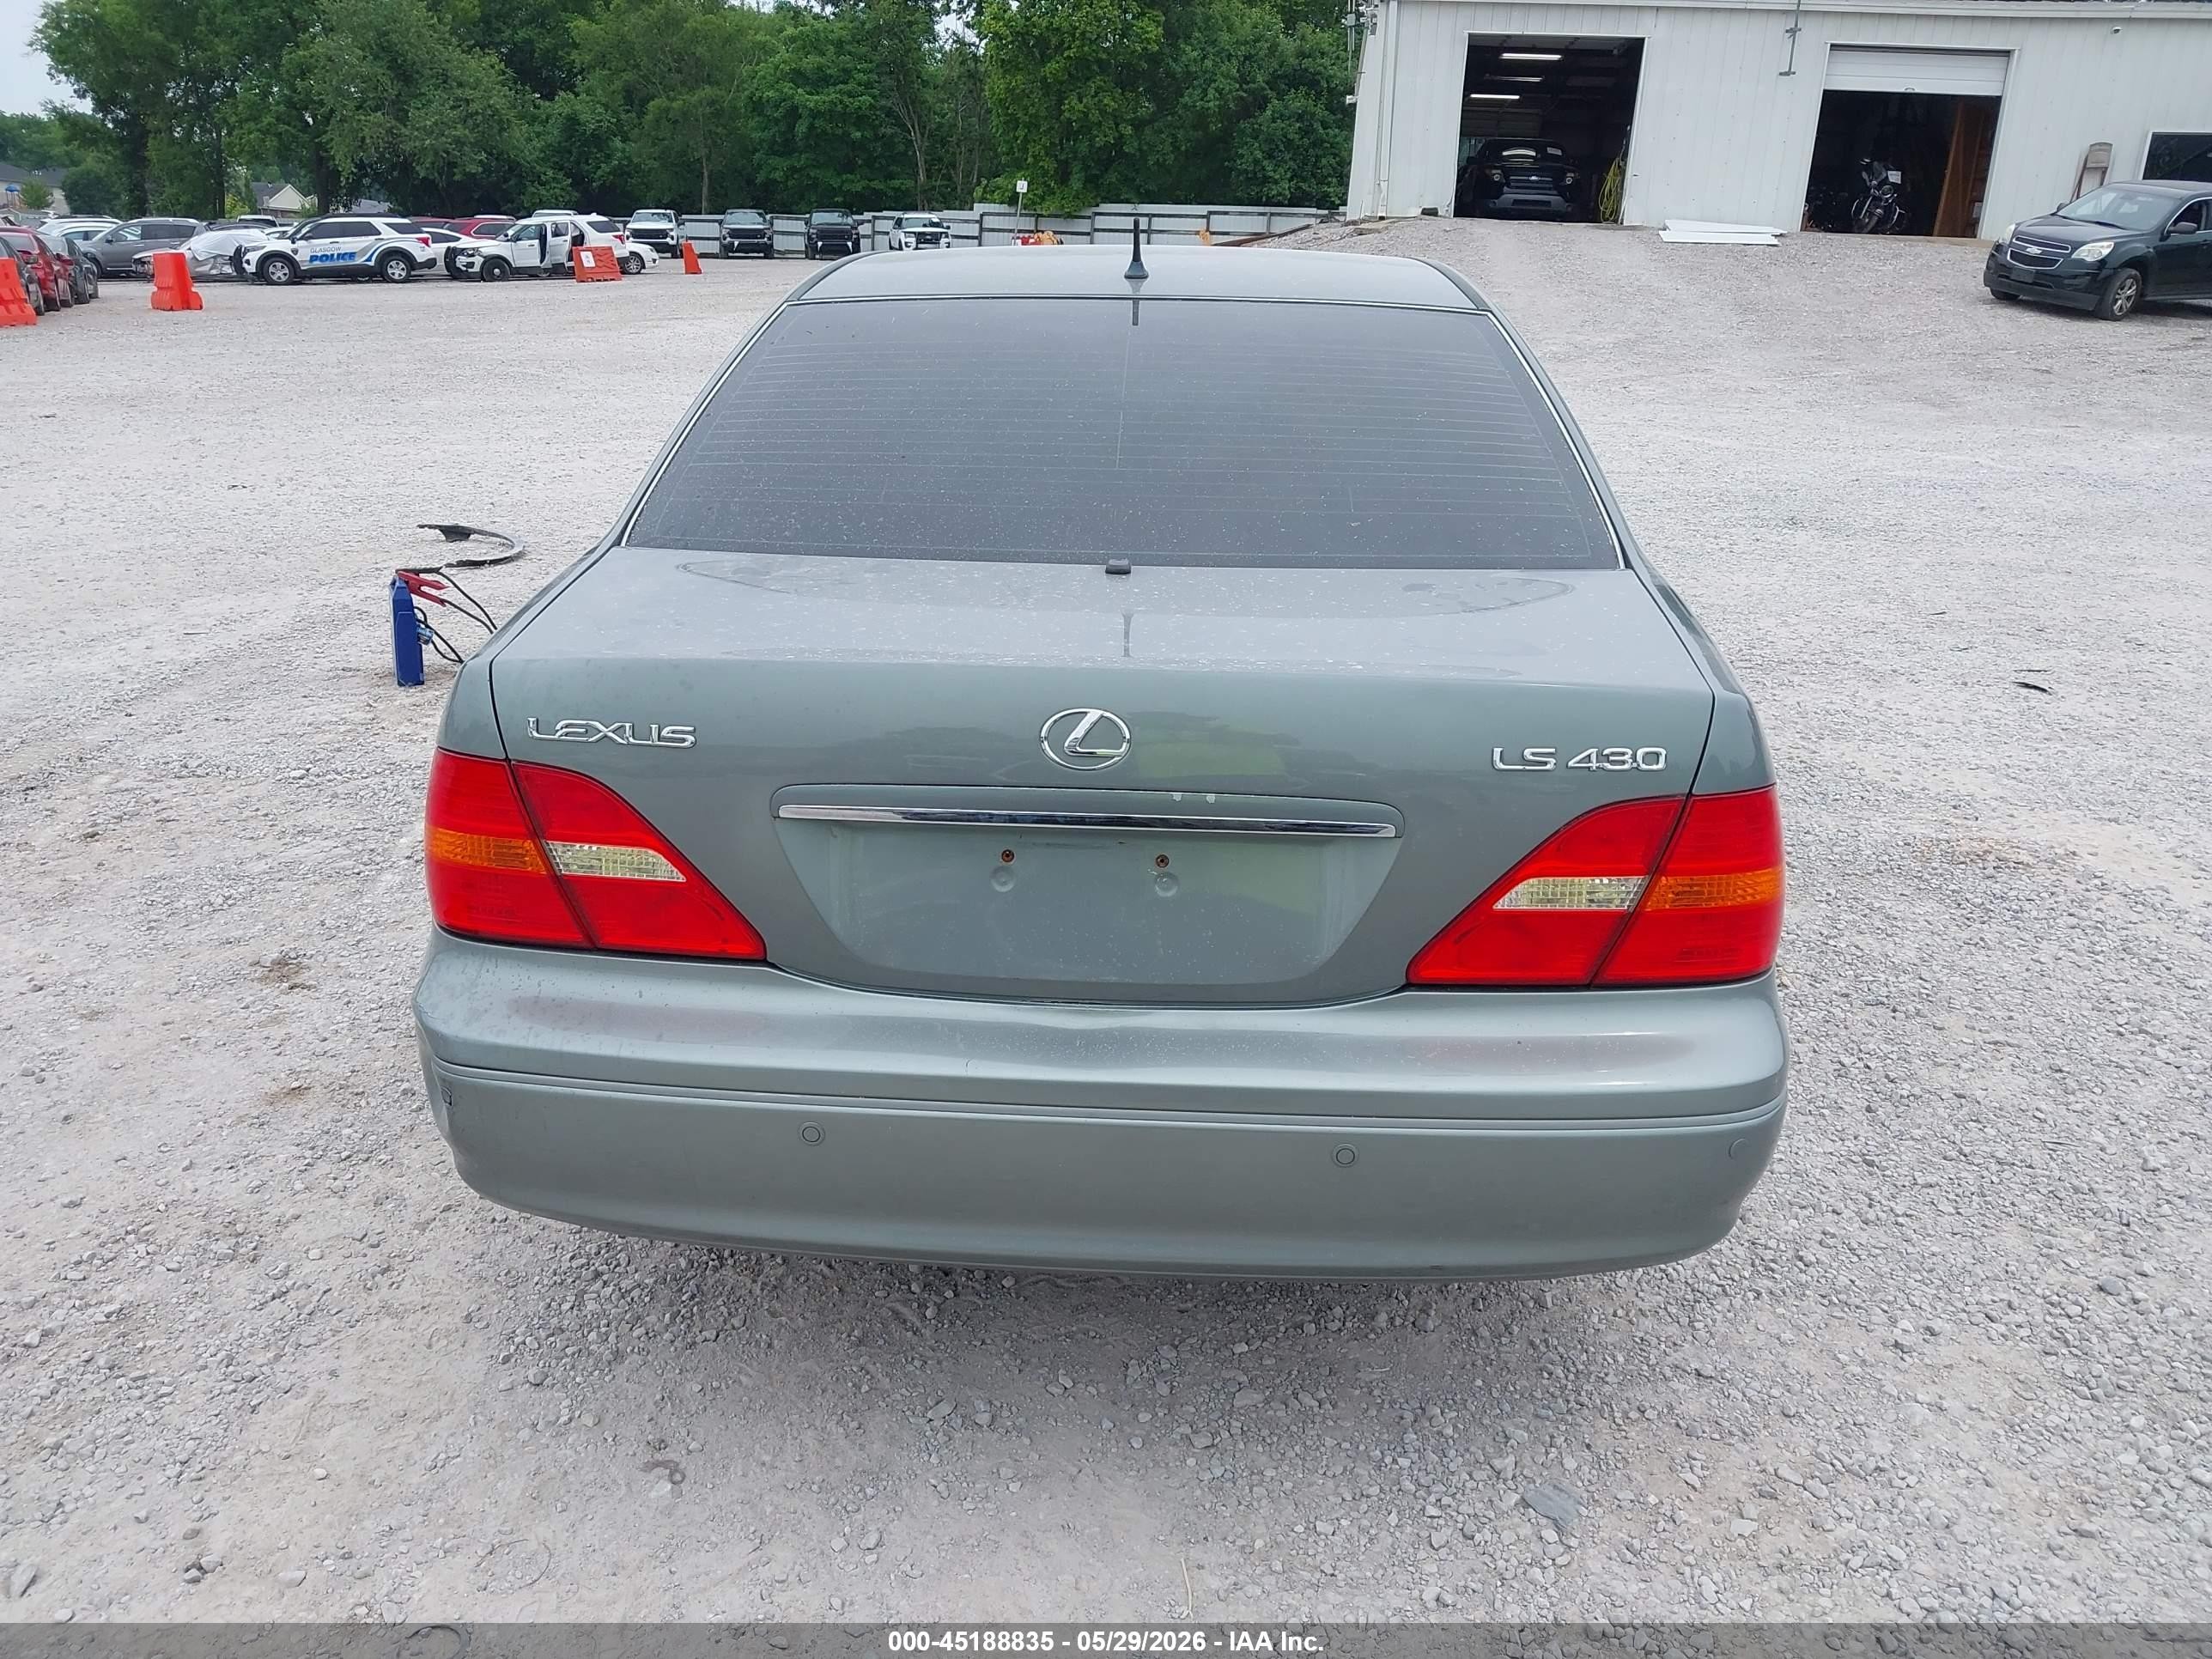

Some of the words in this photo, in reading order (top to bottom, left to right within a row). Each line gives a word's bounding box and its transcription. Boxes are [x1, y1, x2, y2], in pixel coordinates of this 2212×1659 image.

[309, 252, 357, 263] POLICE
[527, 717, 697, 749] LEXUS
[1492, 746, 1557, 771] LS
[1565, 746, 1667, 771] 430
